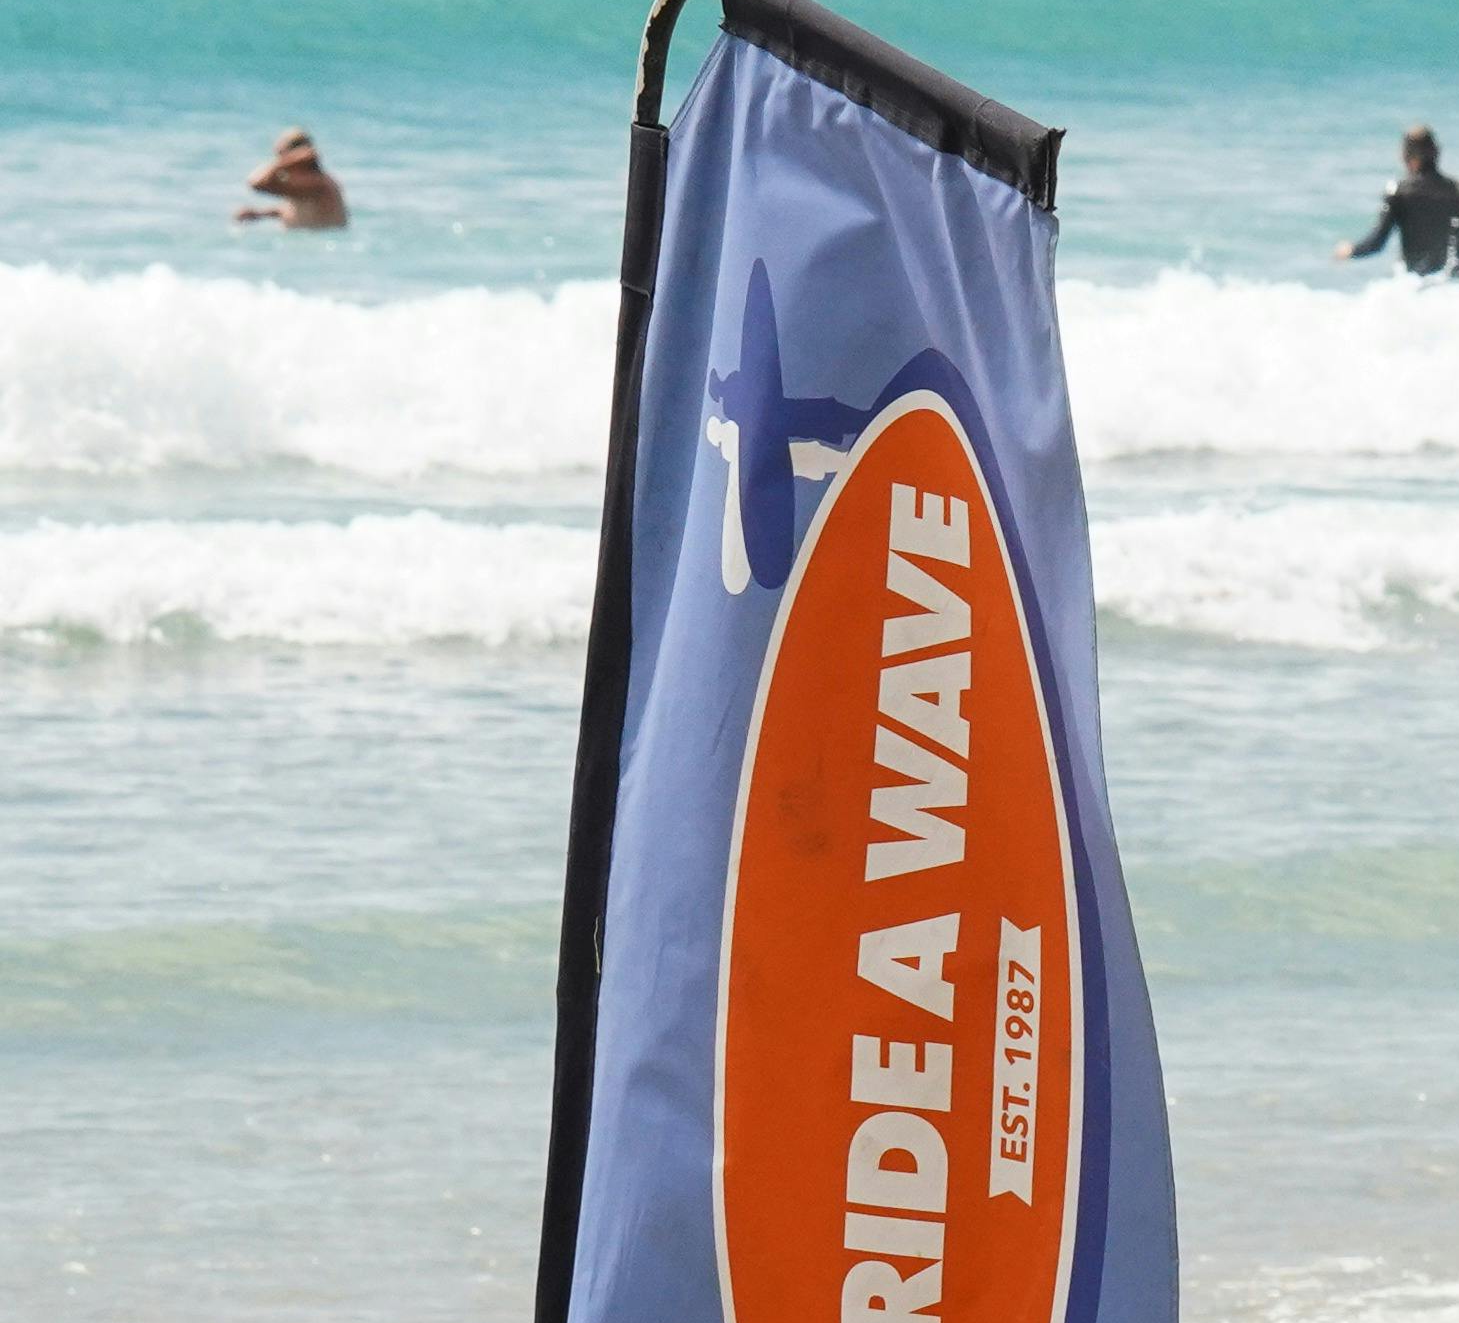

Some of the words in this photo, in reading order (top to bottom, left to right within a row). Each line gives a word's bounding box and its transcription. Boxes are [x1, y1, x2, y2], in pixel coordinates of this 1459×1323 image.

[864, 482, 973, 883] WAVE
[857, 911, 961, 1022] A
[1003, 959, 1036, 1065] 1987
[1000, 1082, 1031, 1163] EST.
